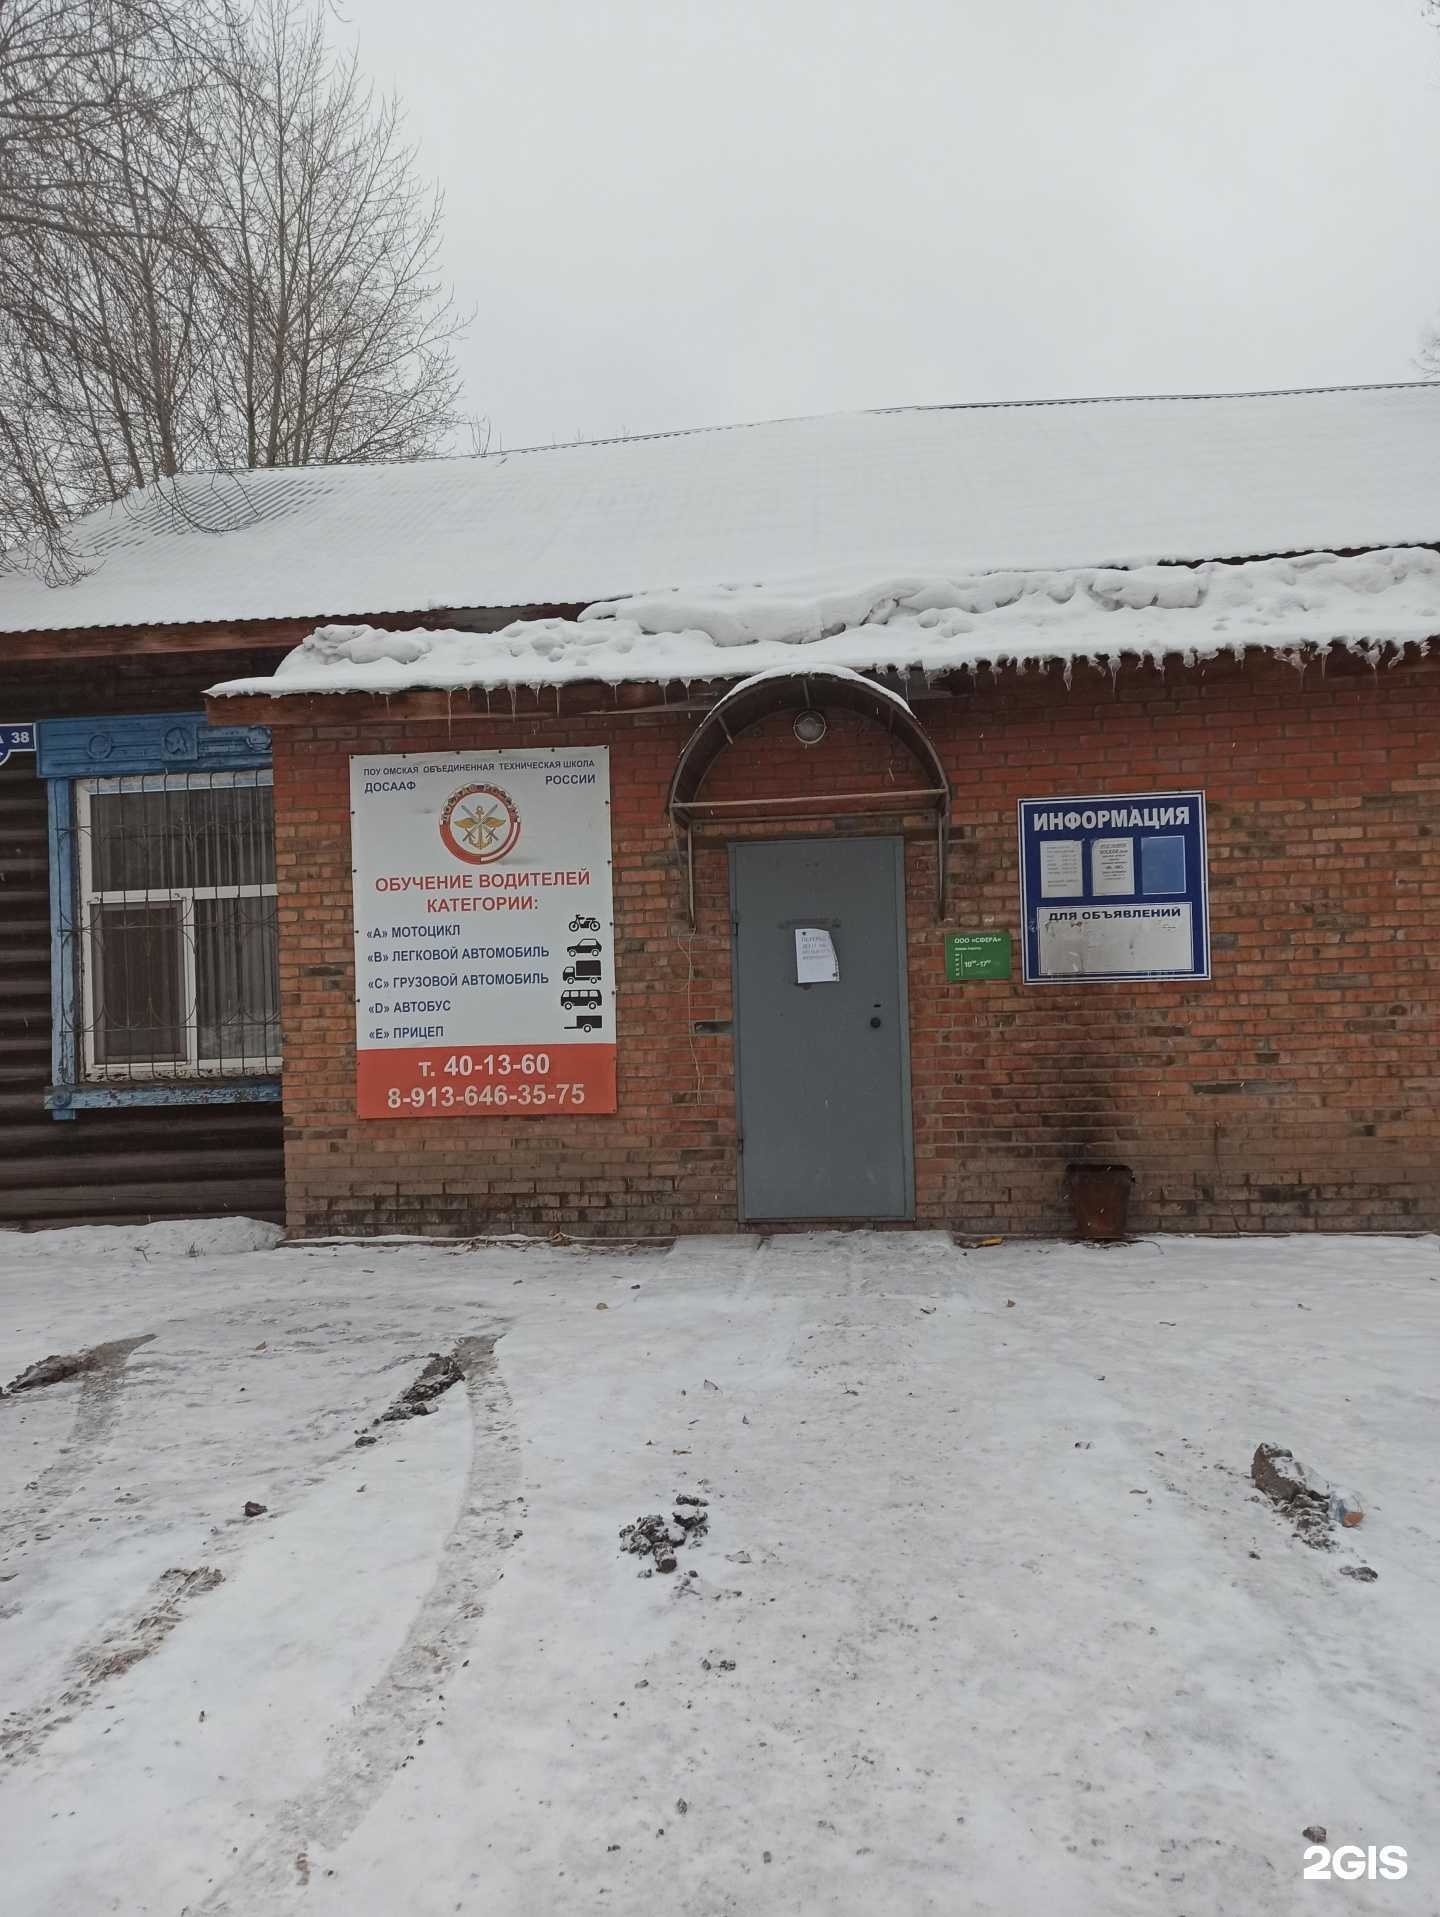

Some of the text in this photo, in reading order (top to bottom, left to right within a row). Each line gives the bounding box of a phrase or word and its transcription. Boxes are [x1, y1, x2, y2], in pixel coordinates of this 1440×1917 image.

[11, 731, 30, 744] 38
[363, 759, 595, 776] ПОУ ОМСКАЯ ОБЪЕДИНЕННАЯ ТЕХНИЧЕСКАЯ ШКОЛА
[364, 774, 596, 794] ДОСААФ РОССИИ
[1033, 806, 1190, 831] ИНФОРМАЦИЯ
[375, 867, 591, 892] ОБУЧЕНИЕ ВОДИТЕЛЕЙ
[427, 896, 539, 913] КАТЕГОРИИ:
[1049, 906, 1181, 921] ДЛЯ ОБЪЯВЛЕНИЙ
[391, 925, 461, 939] МОТОЦИКЛ
[392, 946, 459, 963] ЛЕГКОВОЙ
[461, 946, 550, 960] АВТОМОБИЛЬ
[393, 973, 459, 988] ГРУЗОВОЙ
[461, 972, 549, 986] АВТОМОБИЛЬ
[368, 1000, 451, 1014] «D» АВТОБУС
[393, 1026, 444, 1040] ПРИЦЕП
[444, 1053, 550, 1076] 40-13-60
[387, 1083, 585, 1108] 8-913-646-35-75
